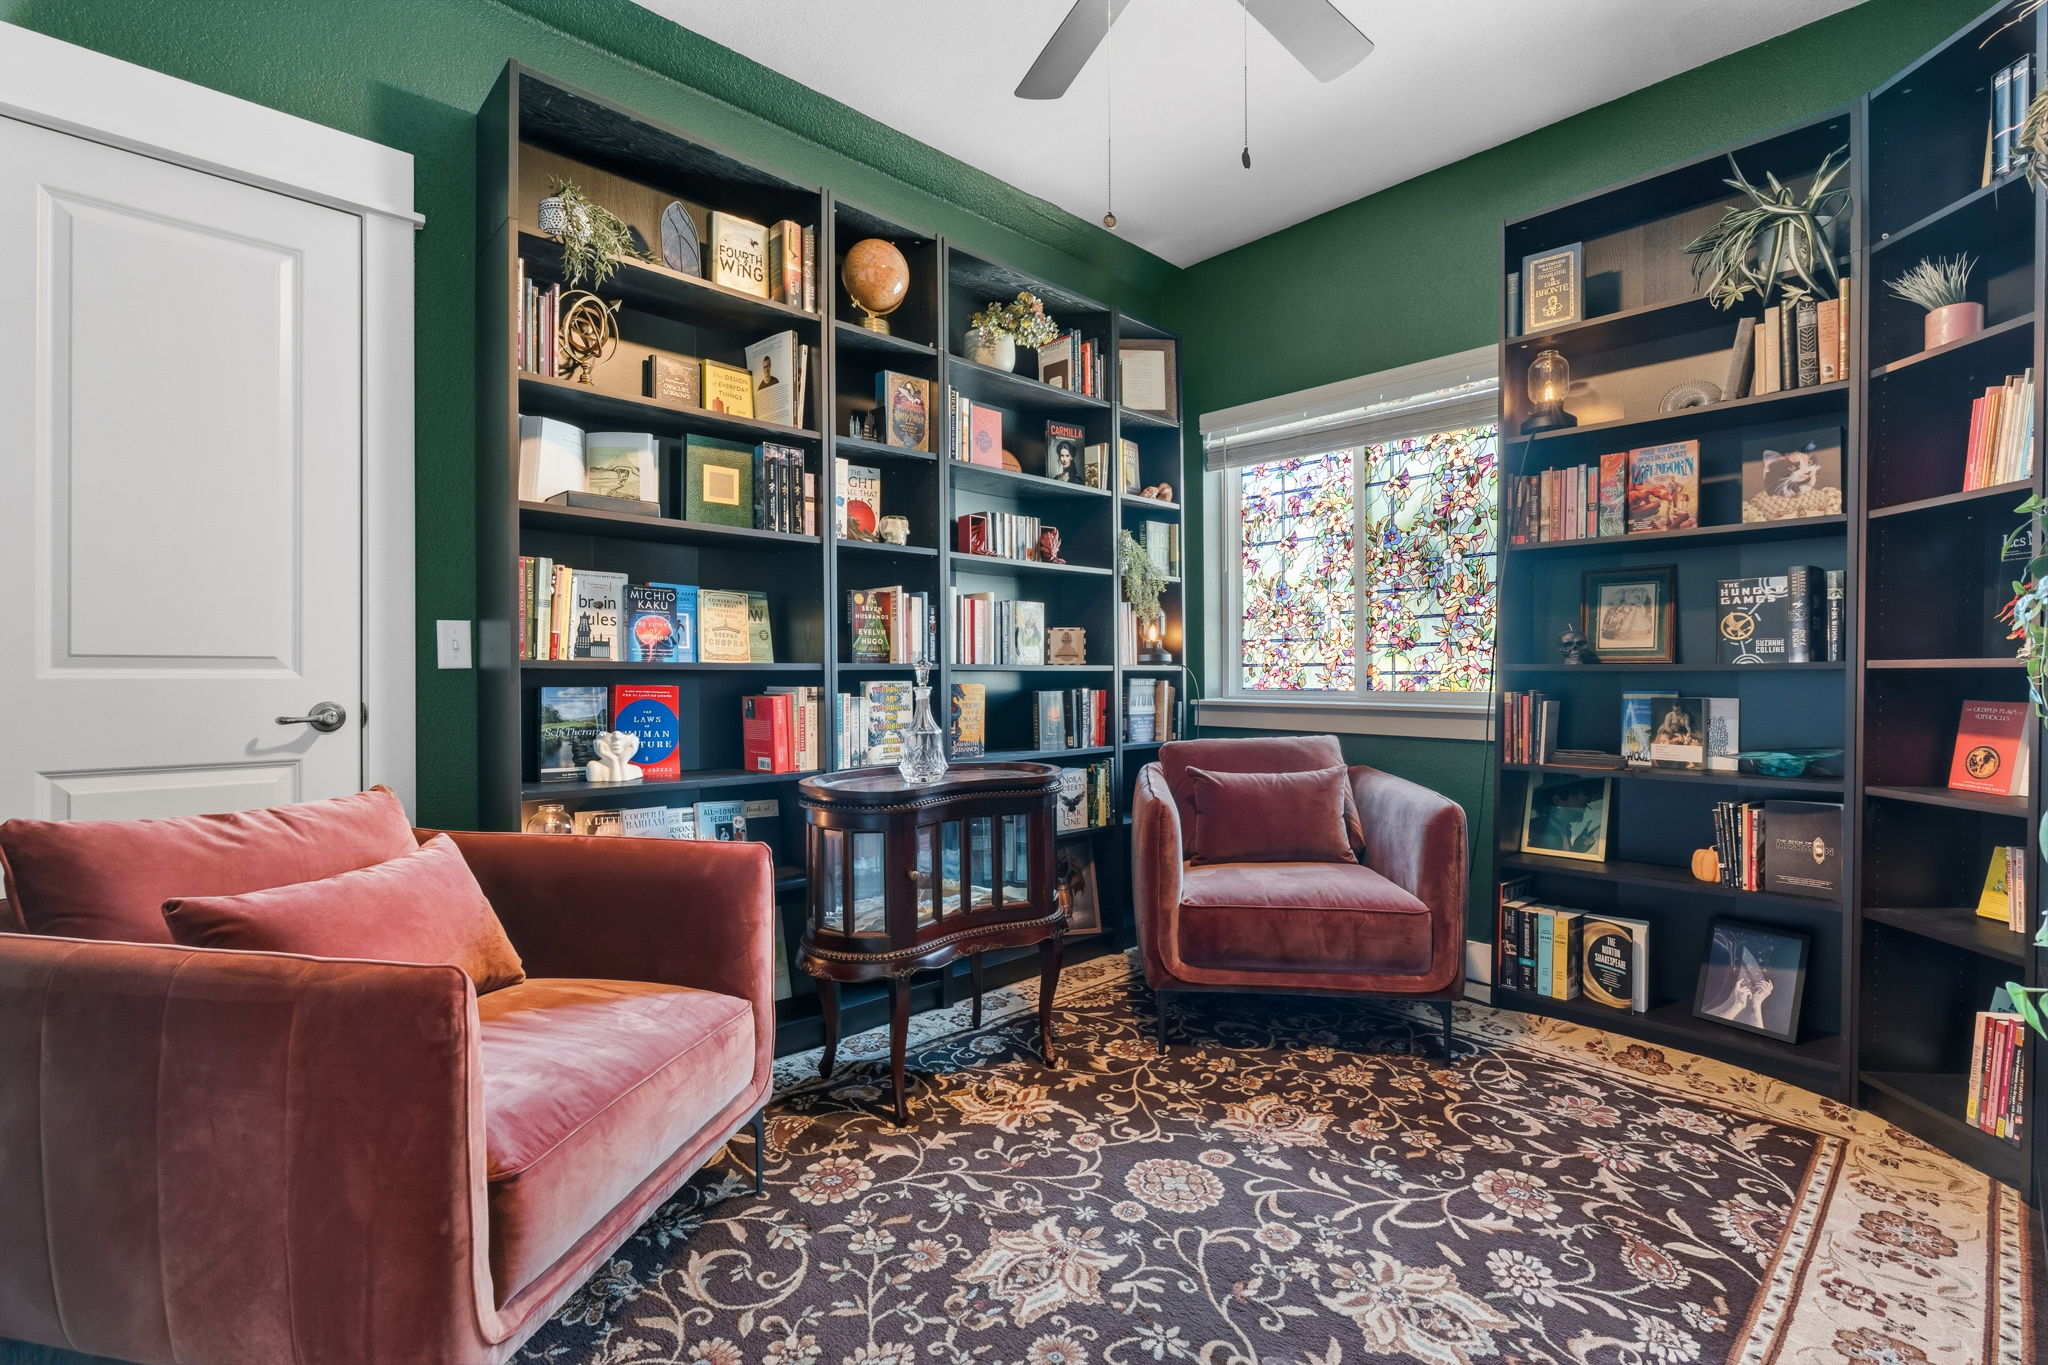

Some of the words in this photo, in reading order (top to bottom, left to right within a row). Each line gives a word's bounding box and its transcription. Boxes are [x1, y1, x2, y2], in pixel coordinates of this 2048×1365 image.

[720, 245, 762, 267] FOURTH
[720, 256, 764, 282] WING
[725, 374, 748, 384] DESIGN
[718, 382, 748, 393] EVERYDAY
[719, 390, 742, 401] THINGS
[1050, 425, 1083, 439] CARMILLA
[848, 476, 876, 489] GHT
[860, 489, 878, 498] THAT
[630, 591, 676, 602] MICHIO
[1720, 585, 1786, 597] HUNGER
[579, 594, 616, 609] brin
[637, 600, 669, 610] KAKU
[1720, 595, 1776, 605] GAMES
[588, 612, 617, 627] ules
[858, 628, 886, 636] EVELYN
[709, 638, 744, 647] CHOPRA
[1755, 639, 1785, 647] SUZANNE
[641, 740, 672, 748] TURE
[1062, 775, 1082, 785] NORA
[1063, 783, 1086, 792] OBERTS
[720, 806, 742, 815] LONELY
[1061, 807, 1082, 818] YEAR
[626, 817, 665, 830] BARHAM
[710, 815, 734, 823] PEOPLE
[1063, 817, 1081, 827] ONE
[1776, 841, 1834, 857] MORMN
[1607, 936, 1616, 947] THE
[1601, 944, 1621, 958] NORTON
[1594, 952, 1627, 970] SHAKESPEARE
